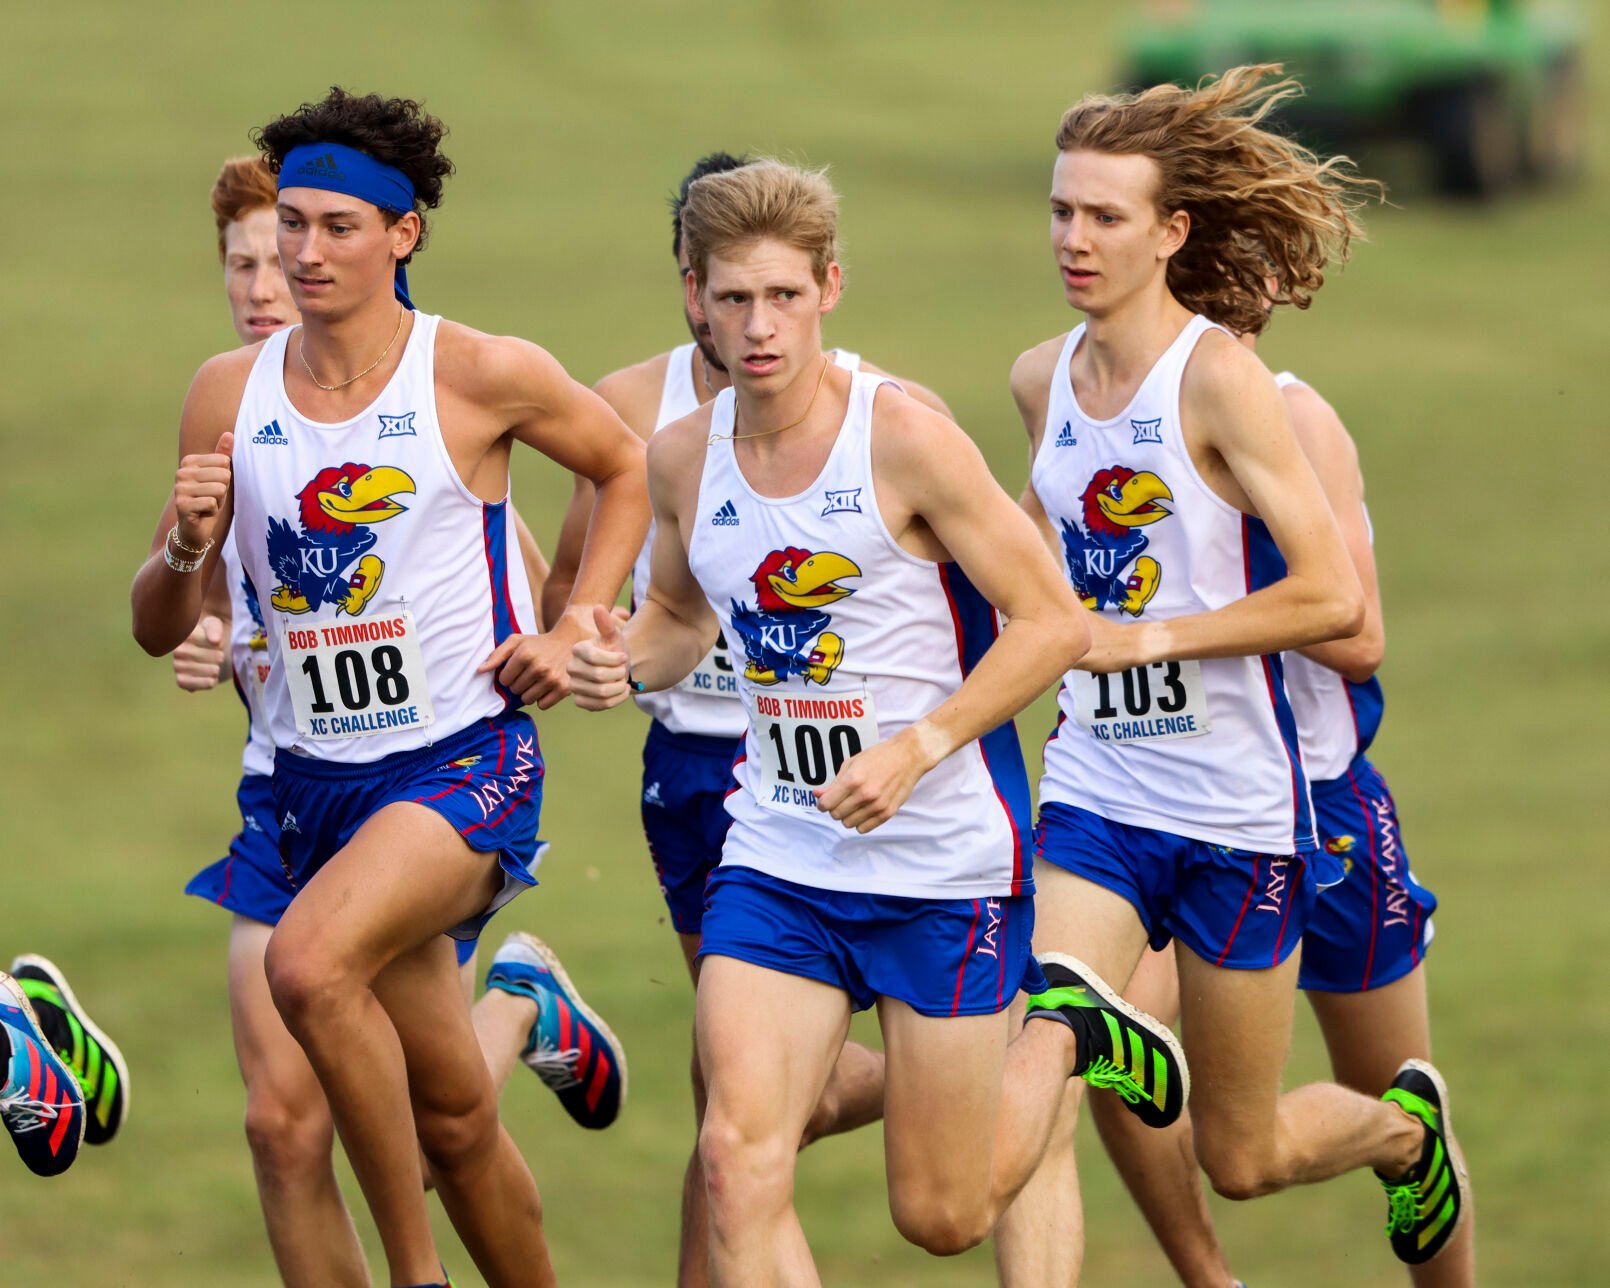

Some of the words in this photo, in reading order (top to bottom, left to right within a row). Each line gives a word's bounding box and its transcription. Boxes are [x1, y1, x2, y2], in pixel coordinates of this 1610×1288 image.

[252, 434, 289, 446] adidas
[711, 516, 740, 527] adidas
[298, 547, 340, 578] KU
[1083, 549, 1117, 579] KU
[288, 629, 319, 650] BOB
[321, 618, 406, 647] TIMMONS
[759, 623, 797, 654] KU
[301, 645, 410, 714] 108
[693, 671, 712, 689] XC
[1091, 660, 1187, 719] 103
[310, 717, 328, 736] XC
[331, 706, 420, 734] CHALLENGE
[757, 695, 781, 717] BOB
[784, 698, 865, 720] TIMMONS
[1091, 724, 1110, 740] XC
[1112, 715, 1197, 740] CHALLENGE
[769, 722, 862, 786] 100
[771, 784, 790, 803] XC
